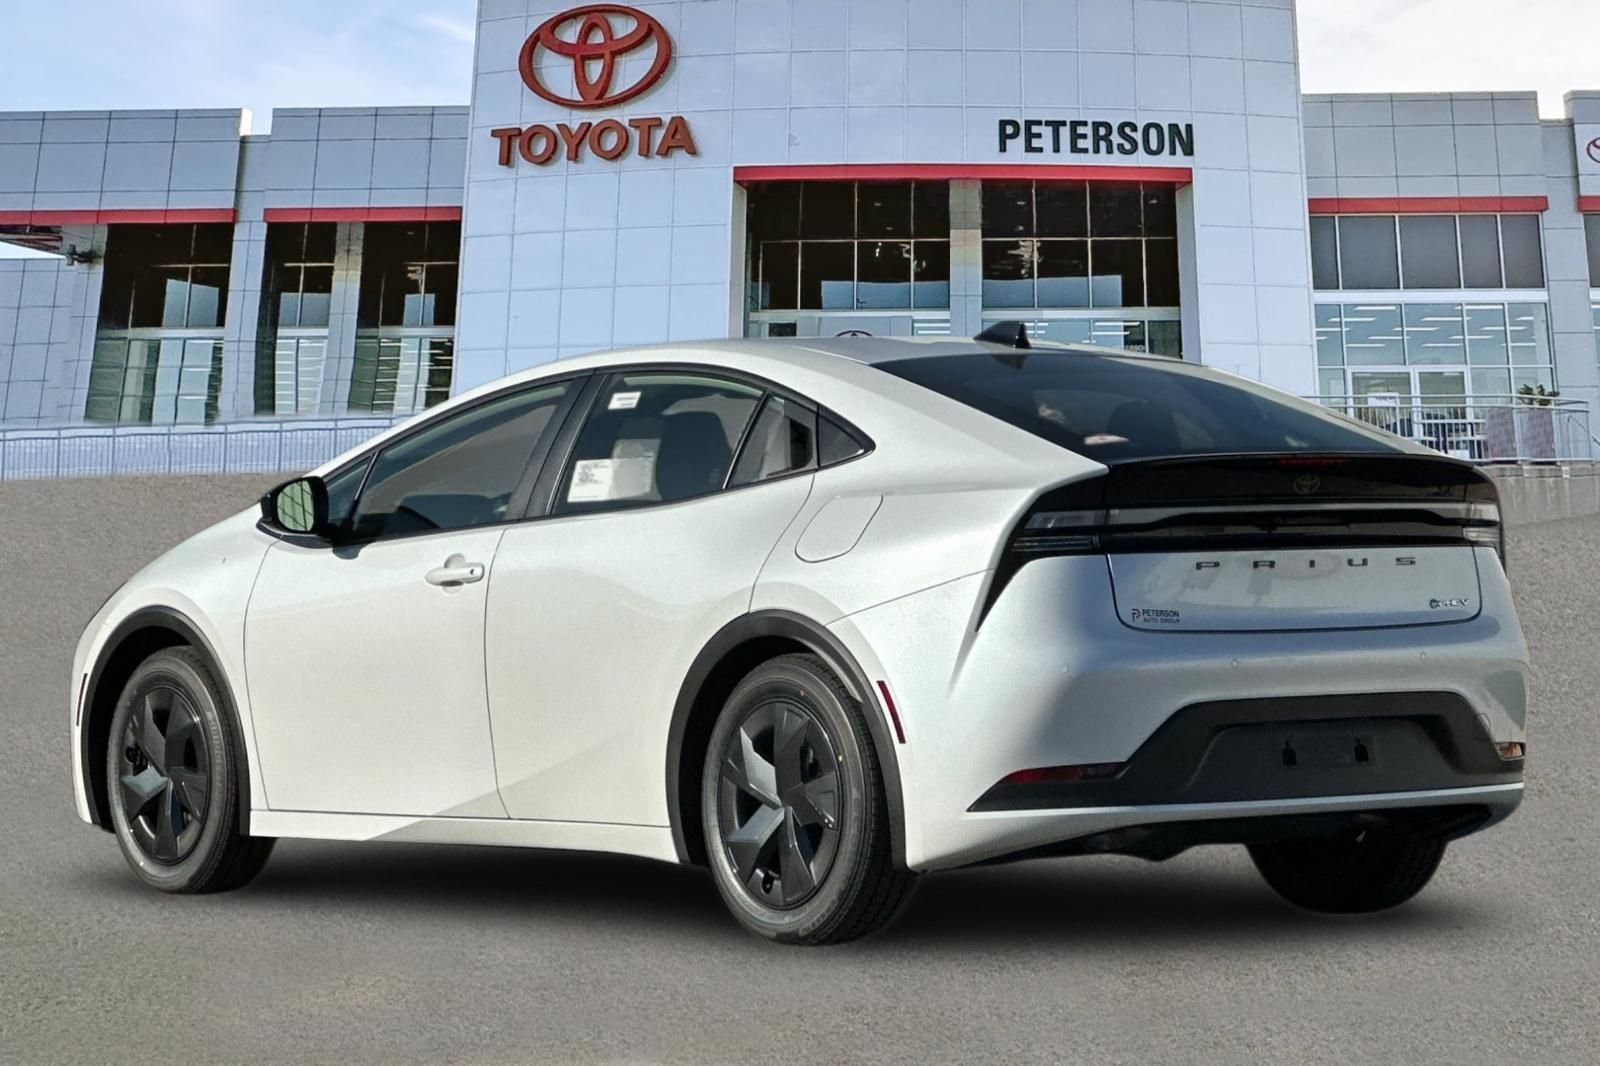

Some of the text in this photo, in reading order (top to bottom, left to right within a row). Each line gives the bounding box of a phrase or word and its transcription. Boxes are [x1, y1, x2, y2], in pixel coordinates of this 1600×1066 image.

[490, 116, 697, 166] TOYOTA
[998, 119, 1194, 156] PETERSON
[1195, 556, 1416, 570] PRIUS
[1142, 608, 1180, 618] PETERSON
